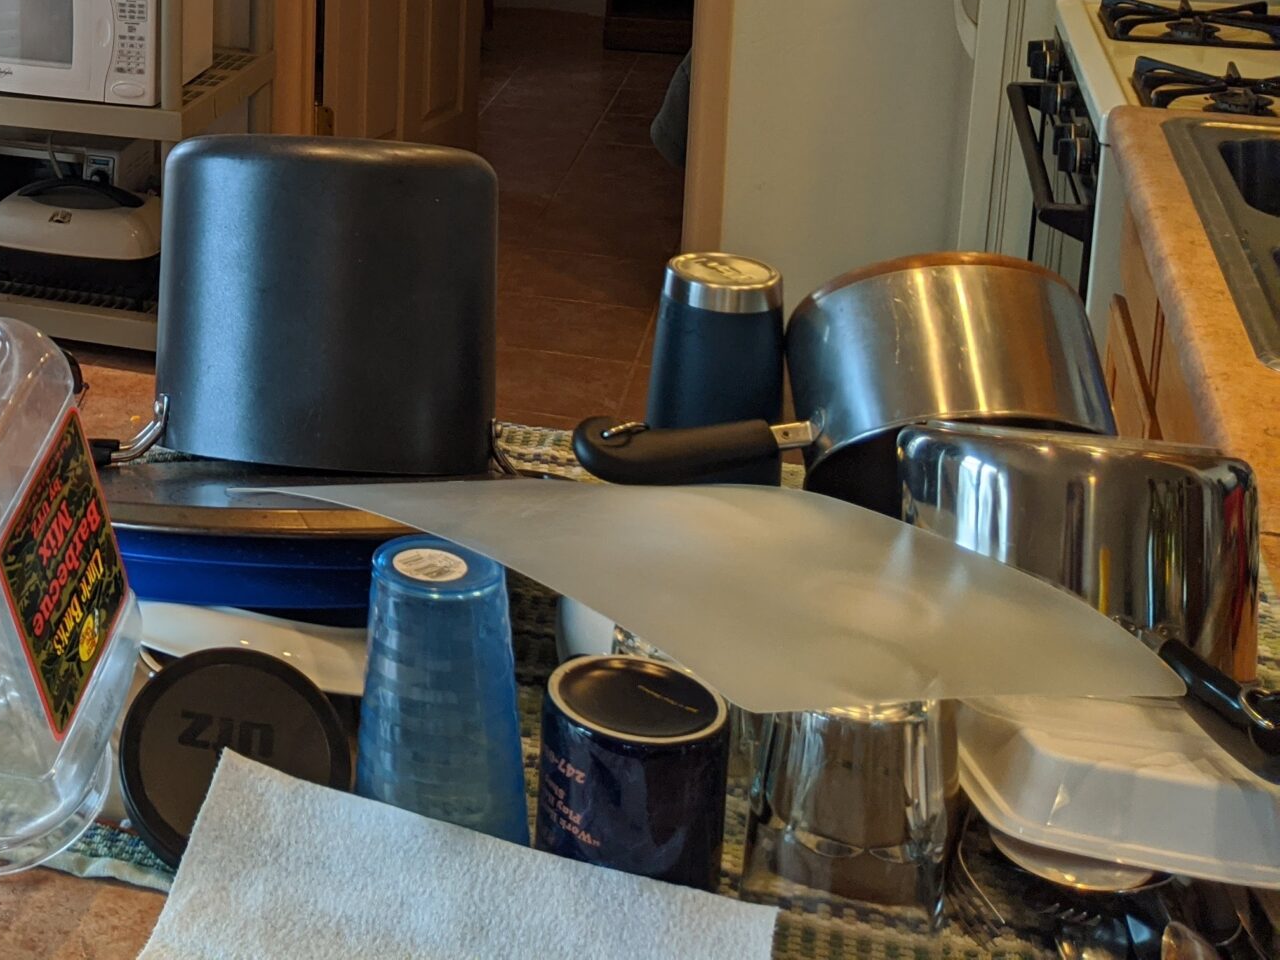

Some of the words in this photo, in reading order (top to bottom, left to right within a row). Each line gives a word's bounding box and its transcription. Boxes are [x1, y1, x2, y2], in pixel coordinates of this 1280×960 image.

[48, 481, 63, 501] by
[30, 502, 51, 540] UTZ
[38, 503, 74, 566] Mix
[32, 498, 101, 637] Barbecue
[81, 548, 104, 603] Uncle
[178, 710, 274, 759] UTZ
